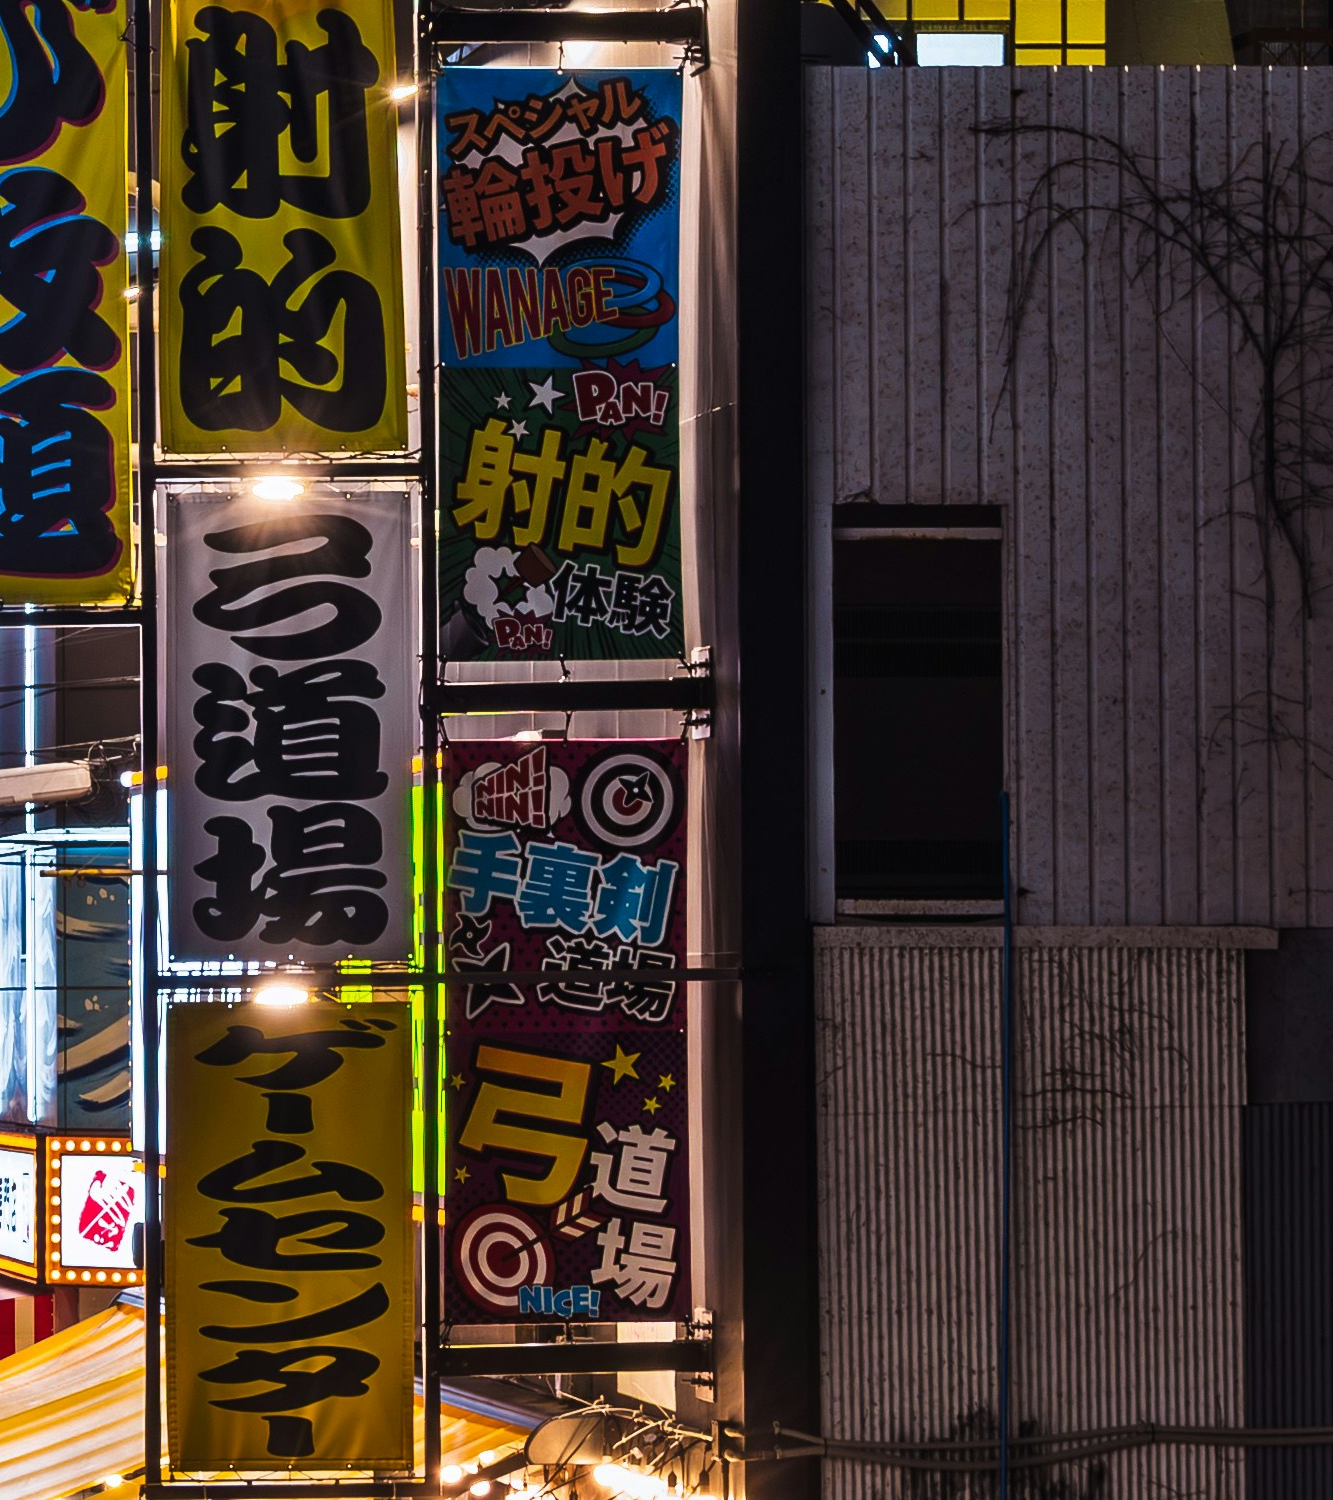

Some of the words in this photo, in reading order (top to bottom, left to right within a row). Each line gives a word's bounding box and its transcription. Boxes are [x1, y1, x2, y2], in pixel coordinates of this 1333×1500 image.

[449, 80, 643, 156] スペシャル
[179, 5, 386, 432] 射的
[444, 125, 670, 247] 輪投げ
[443, 266, 619, 360] WANAGE
[572, 371, 669, 426] PAN!
[453, 418, 674, 567] 射的
[494, 616, 554, 651] PAN!
[552, 560, 675, 638] 体験
[474, 746, 547, 799] NIN!
[474, 786, 547, 829] NIN!
[448, 831, 679, 946] 手裏剣
[537, 936, 676, 1021] 道場
[459, 1044, 592, 1204] 弓
[185, 1015, 399, 1458] ゲームセンター
[591, 1121, 676, 1309] 道場
[518, 1284, 600, 1318] NICE!
